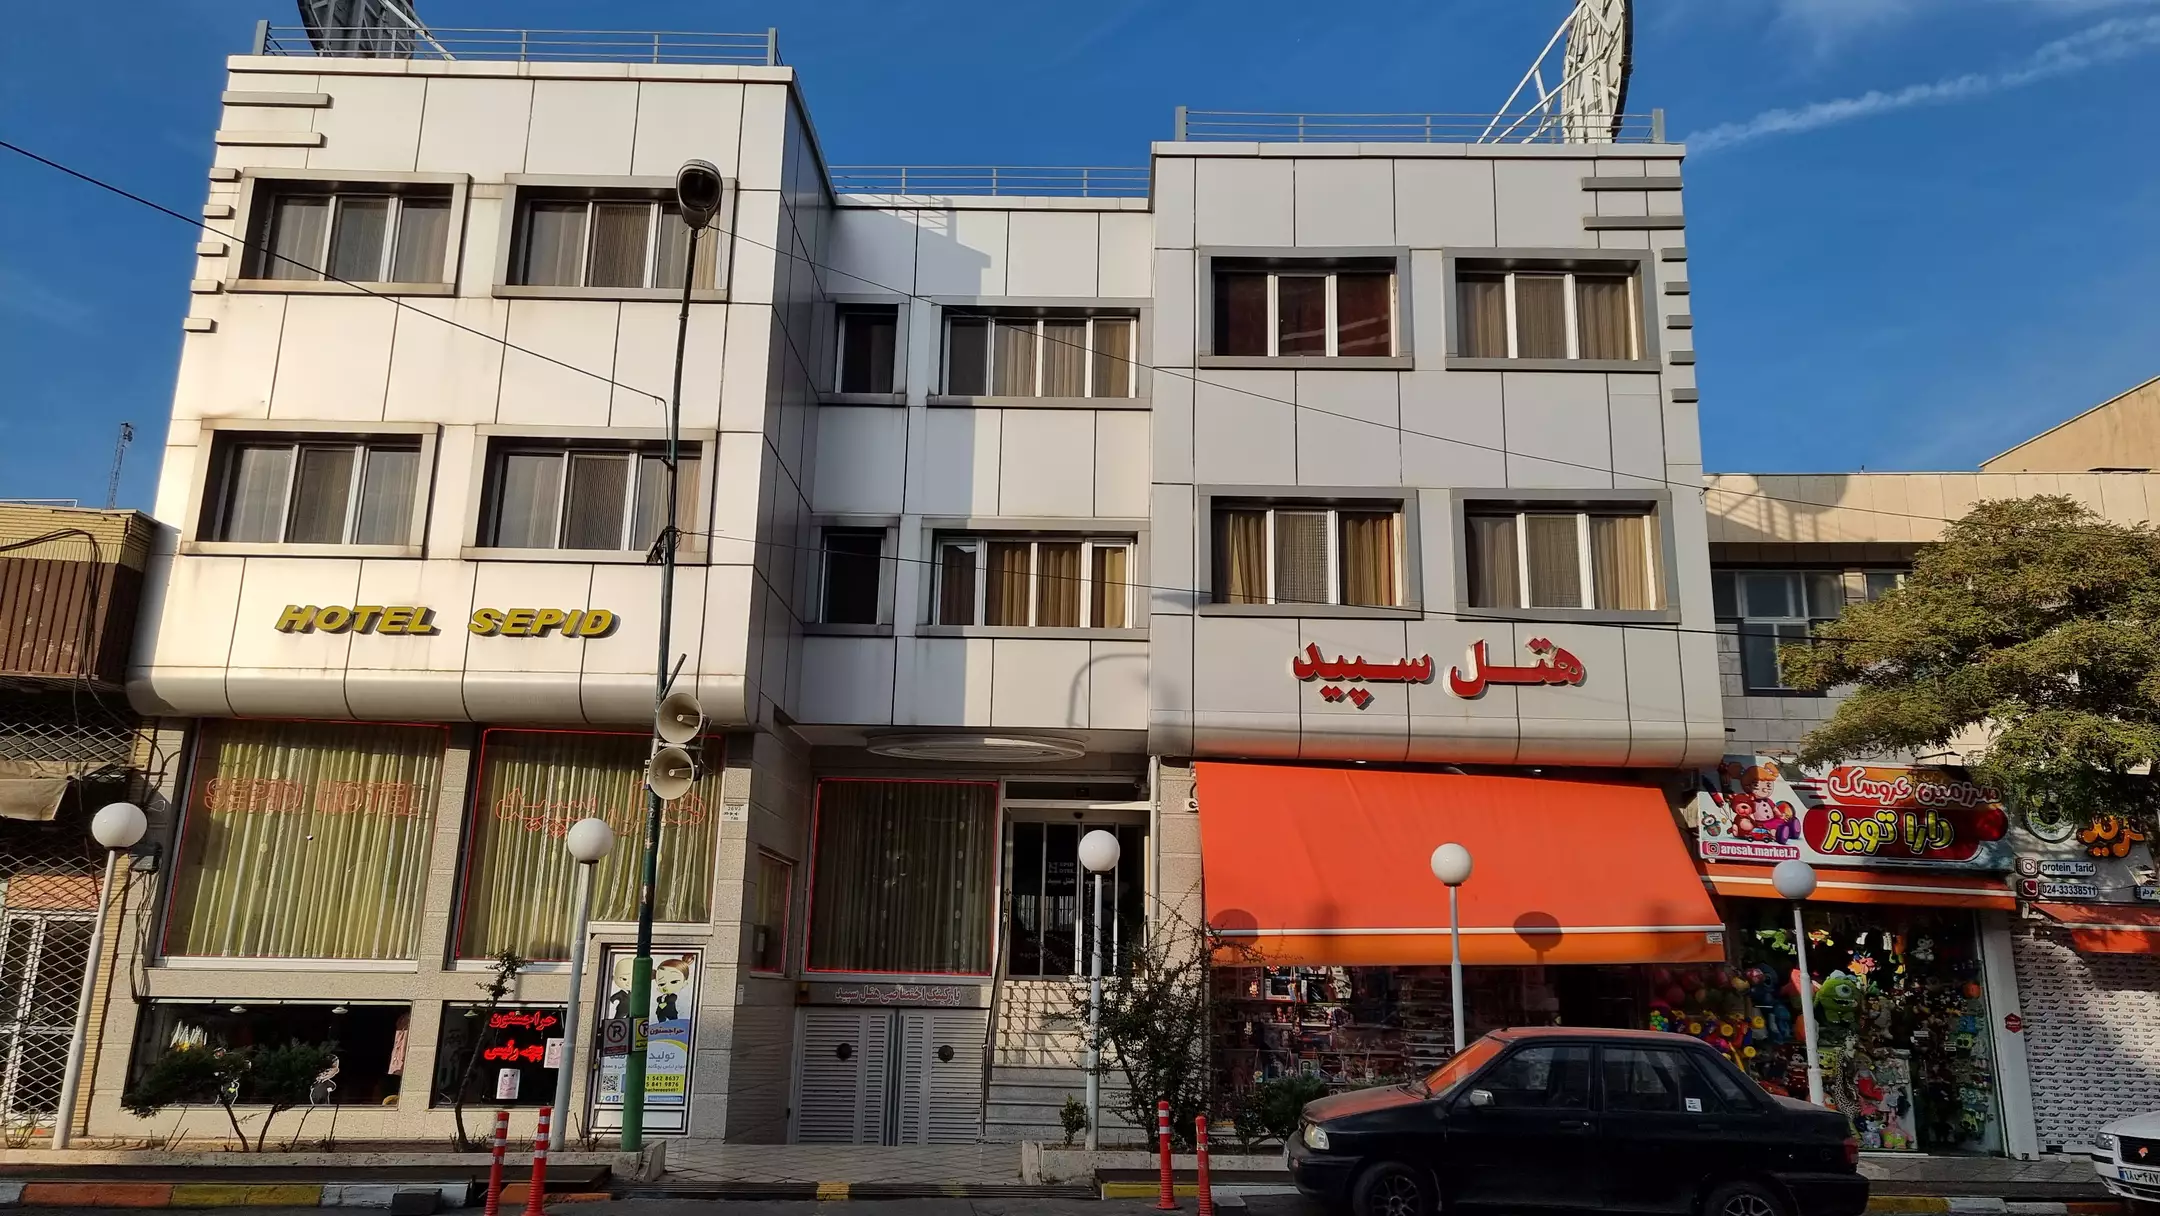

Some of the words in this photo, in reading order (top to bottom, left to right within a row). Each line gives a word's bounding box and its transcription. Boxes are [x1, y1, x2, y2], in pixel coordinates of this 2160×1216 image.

[274, 604, 441, 637] HOTEL
[468, 608, 621, 639] SEPID
[1291, 641, 1435, 711] سپید
[1443, 637, 1587, 700] هتل
[204, 777, 302, 812] SEPID
[316, 780, 421, 816] HOTEL
[1829, 767, 1912, 805] عروسک
[1915, 782, 2002, 808] سرزمین
[496, 787, 597, 838] سپید
[1821, 809, 1898, 855] تویز
[1904, 809, 1954, 854] دارا
[1720, 845, 1798, 858] arosak.market.ir
[2042, 863, 2095, 875] protein_farid
[2042, 884, 2097, 896] 024-33338511
[835, 987, 859, 1004] سپید
[859, 984, 881, 1003] هتل
[880, 985, 926, 1004] اختصاصی
[649, 1051, 675, 1062] تولید
